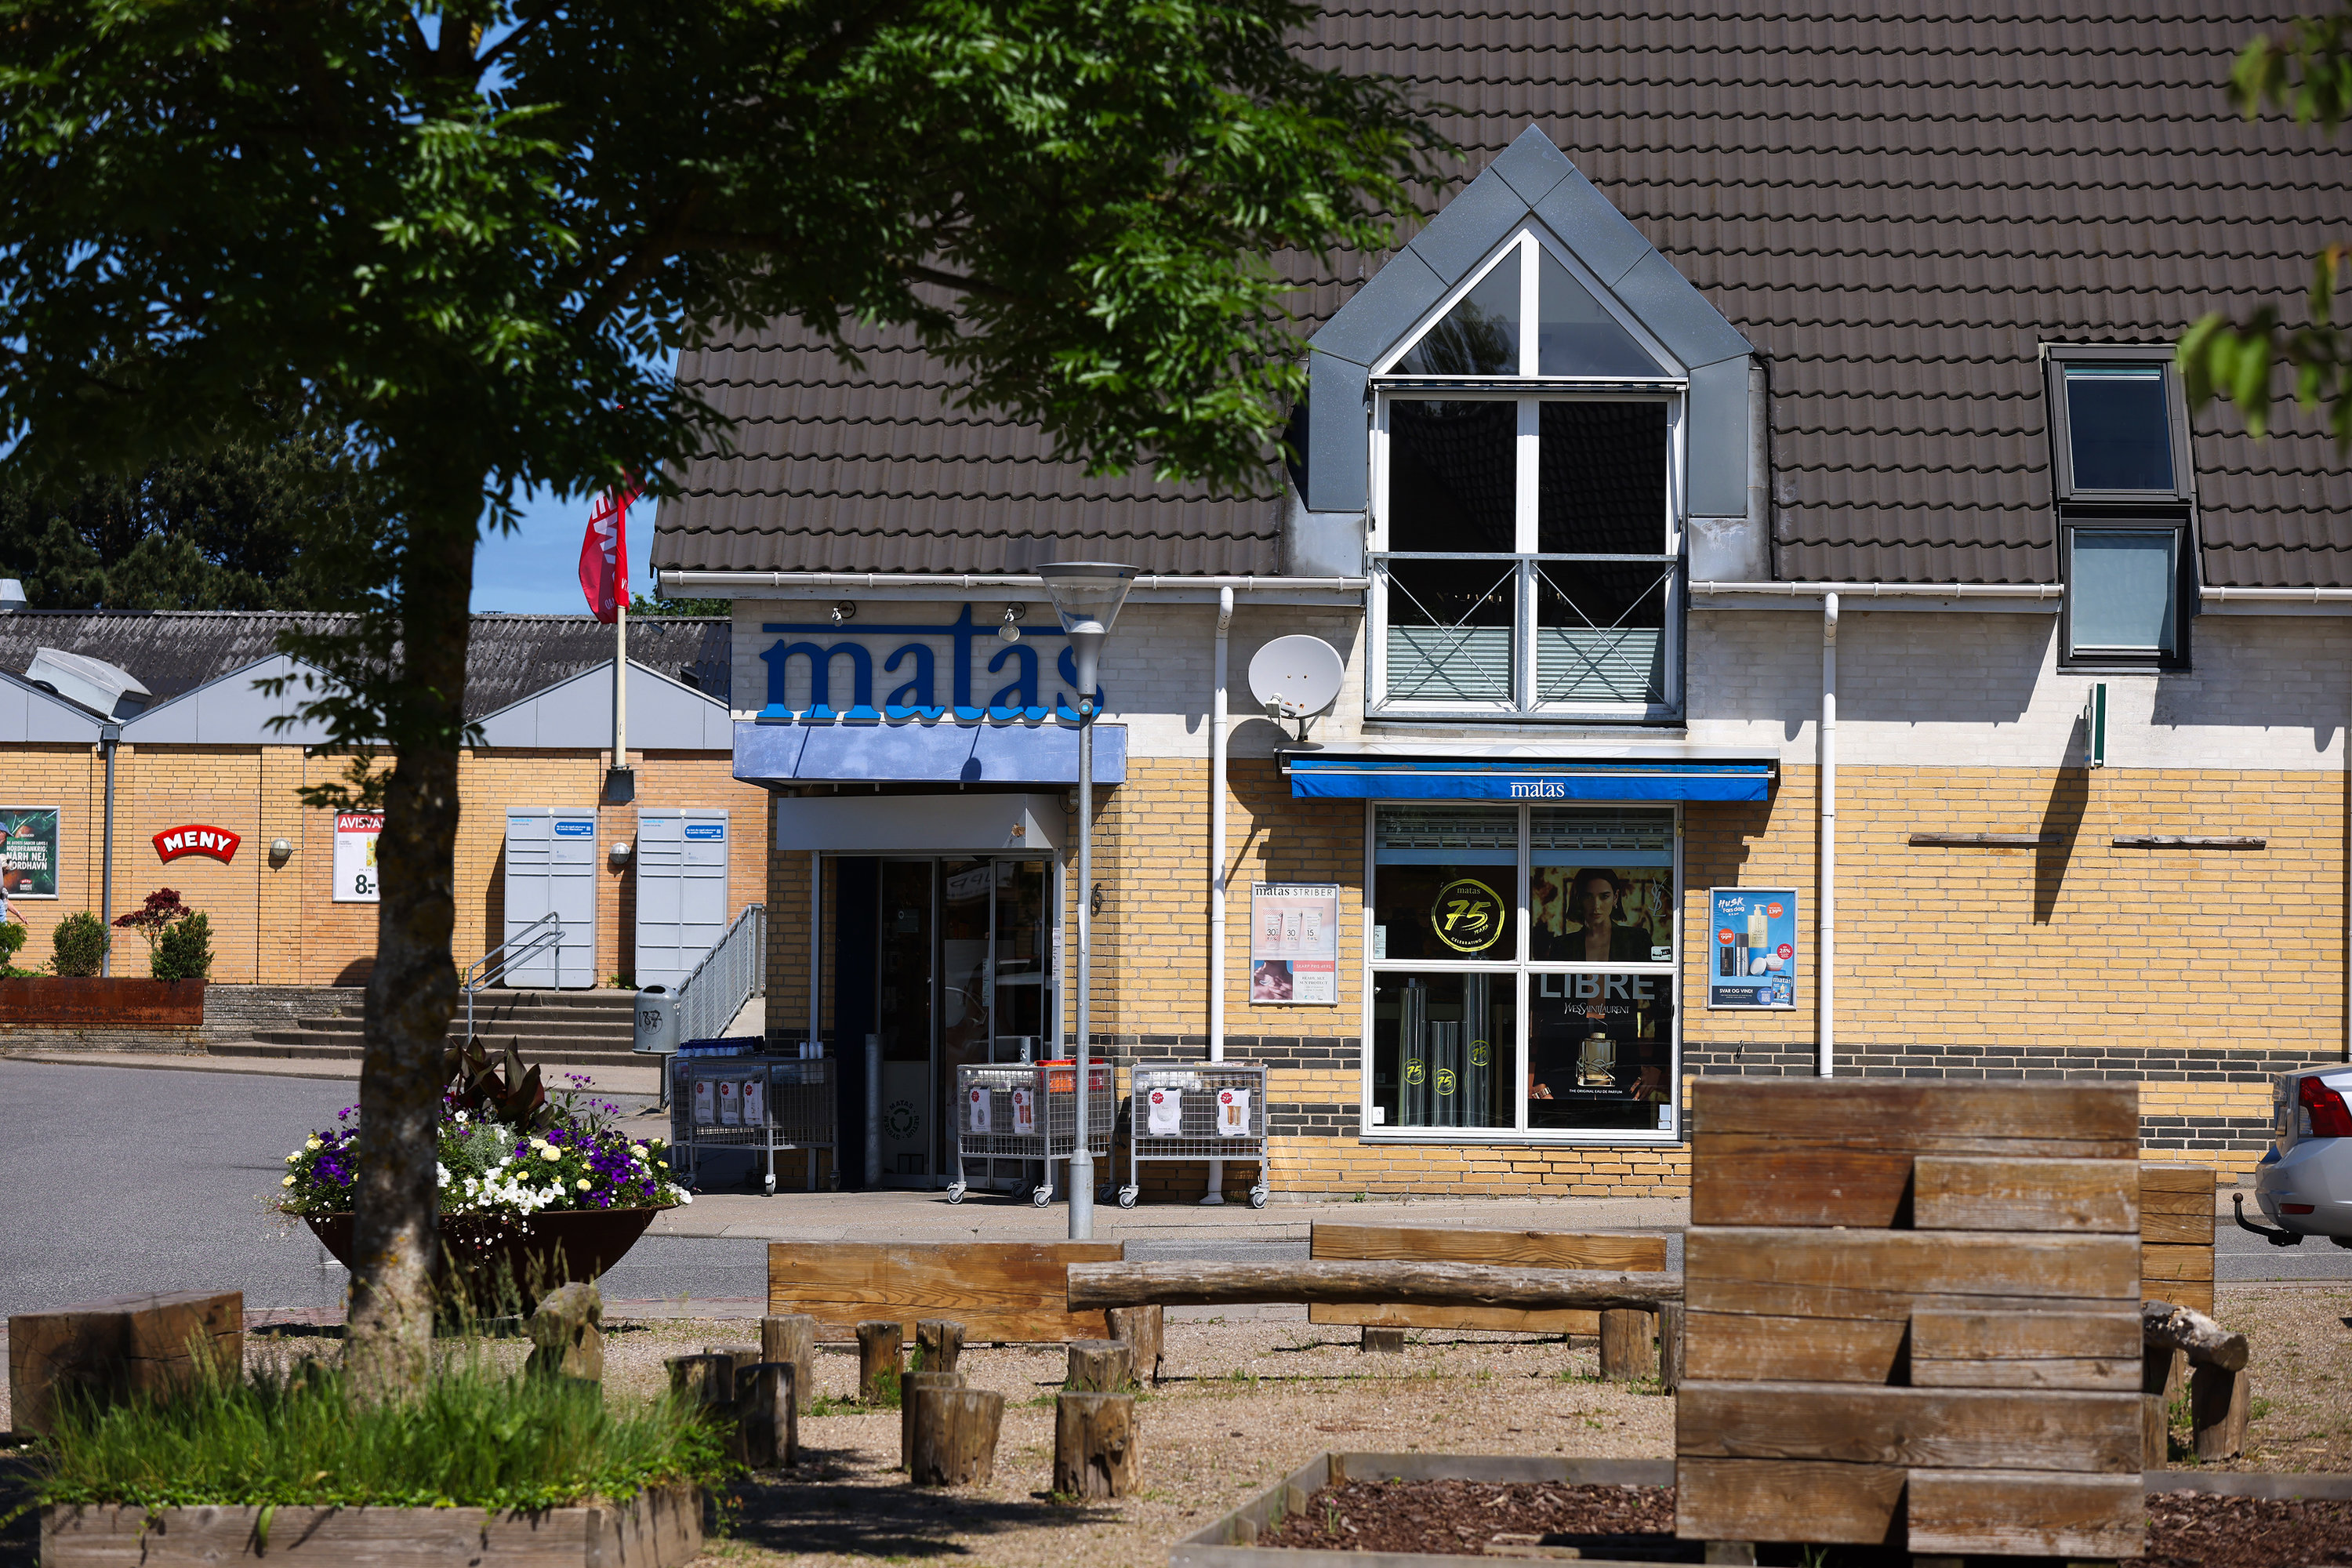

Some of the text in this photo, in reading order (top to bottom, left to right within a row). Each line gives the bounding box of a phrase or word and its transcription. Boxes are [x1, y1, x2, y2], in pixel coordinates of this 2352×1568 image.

[757, 603, 1105, 720] matas
[1510, 779, 1565, 797] matas
[163, 831, 232, 853] MENY
[11, 861, 47, 870] ORDHAVN
[1256, 887, 1290, 896] matas
[1444, 899, 1491, 931] 75
[1474, 924, 1489, 935] YEARS
[1540, 973, 1655, 1000] LIBRE
